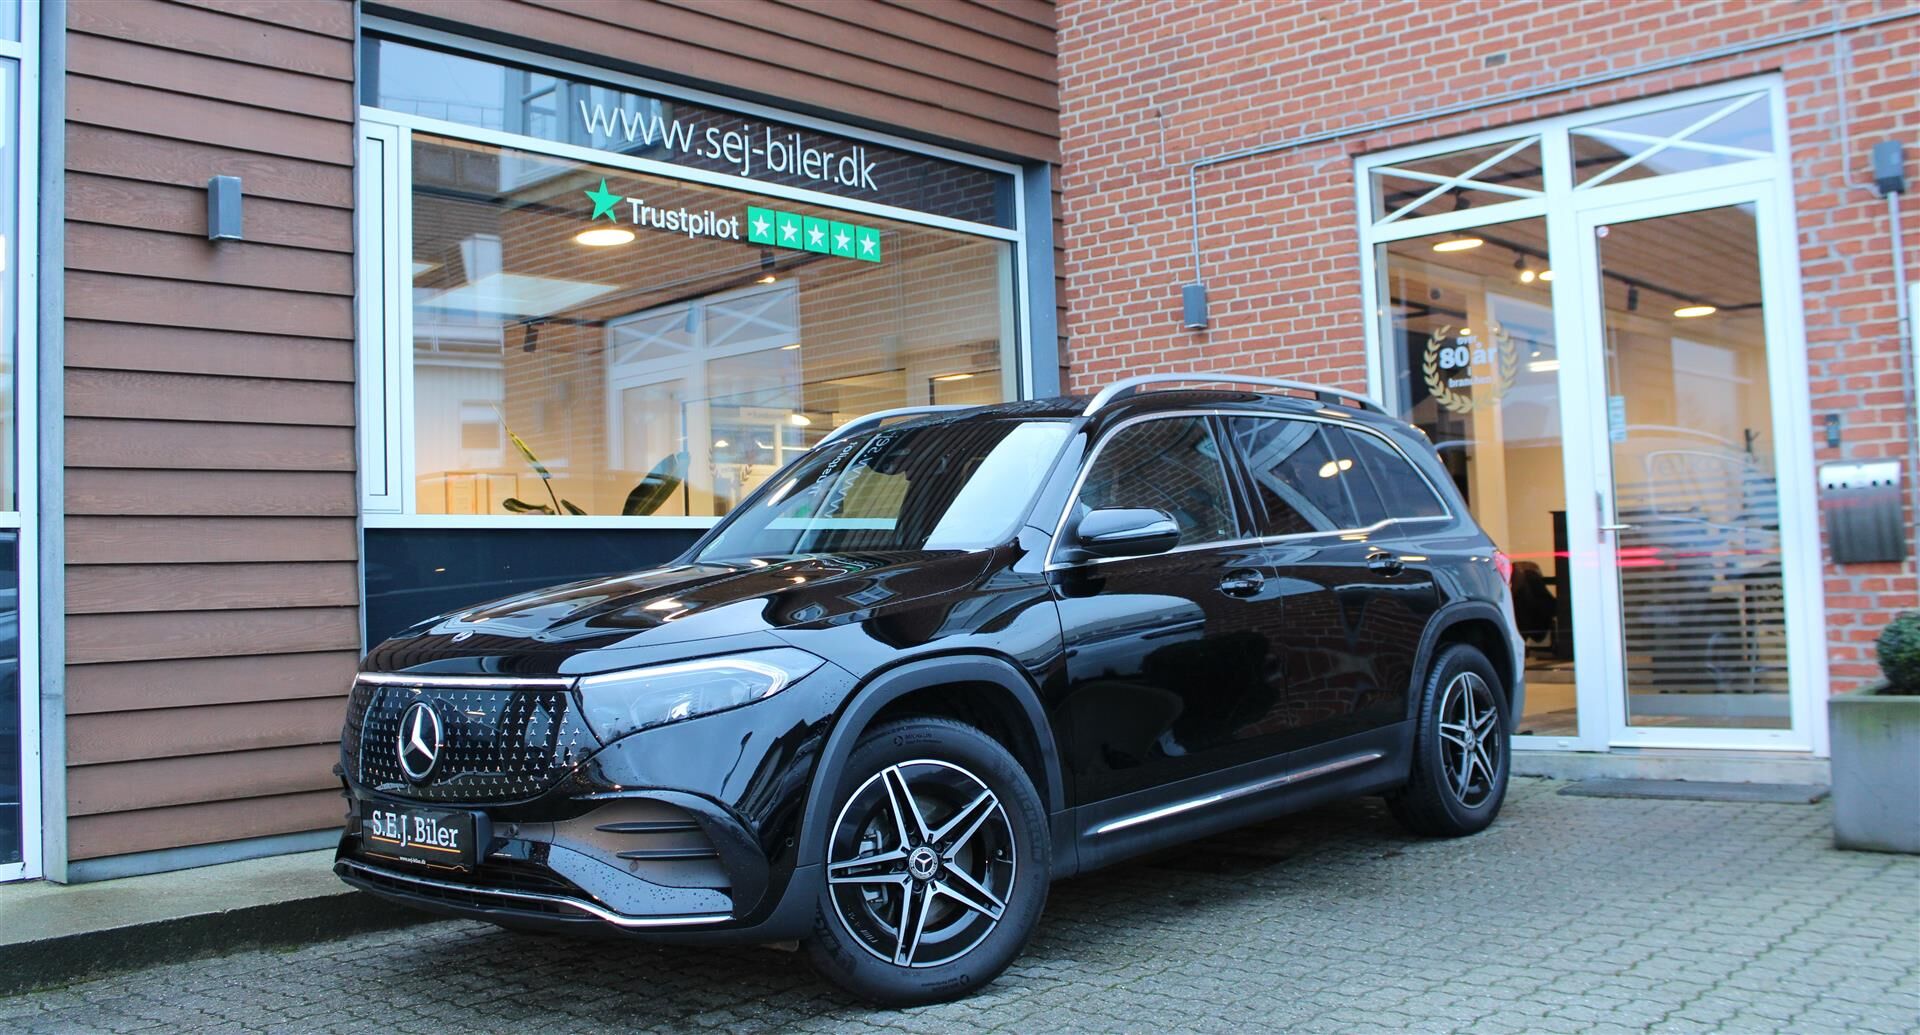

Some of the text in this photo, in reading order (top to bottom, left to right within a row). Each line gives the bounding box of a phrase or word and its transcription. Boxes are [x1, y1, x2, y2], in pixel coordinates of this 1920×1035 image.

[580, 99, 878, 191] www.sej-biler.dk
[626, 197, 740, 240] Trustpilot
[1439, 342, 1498, 369] 80 år
[372, 810, 459, 848] S.E.J. Biler
